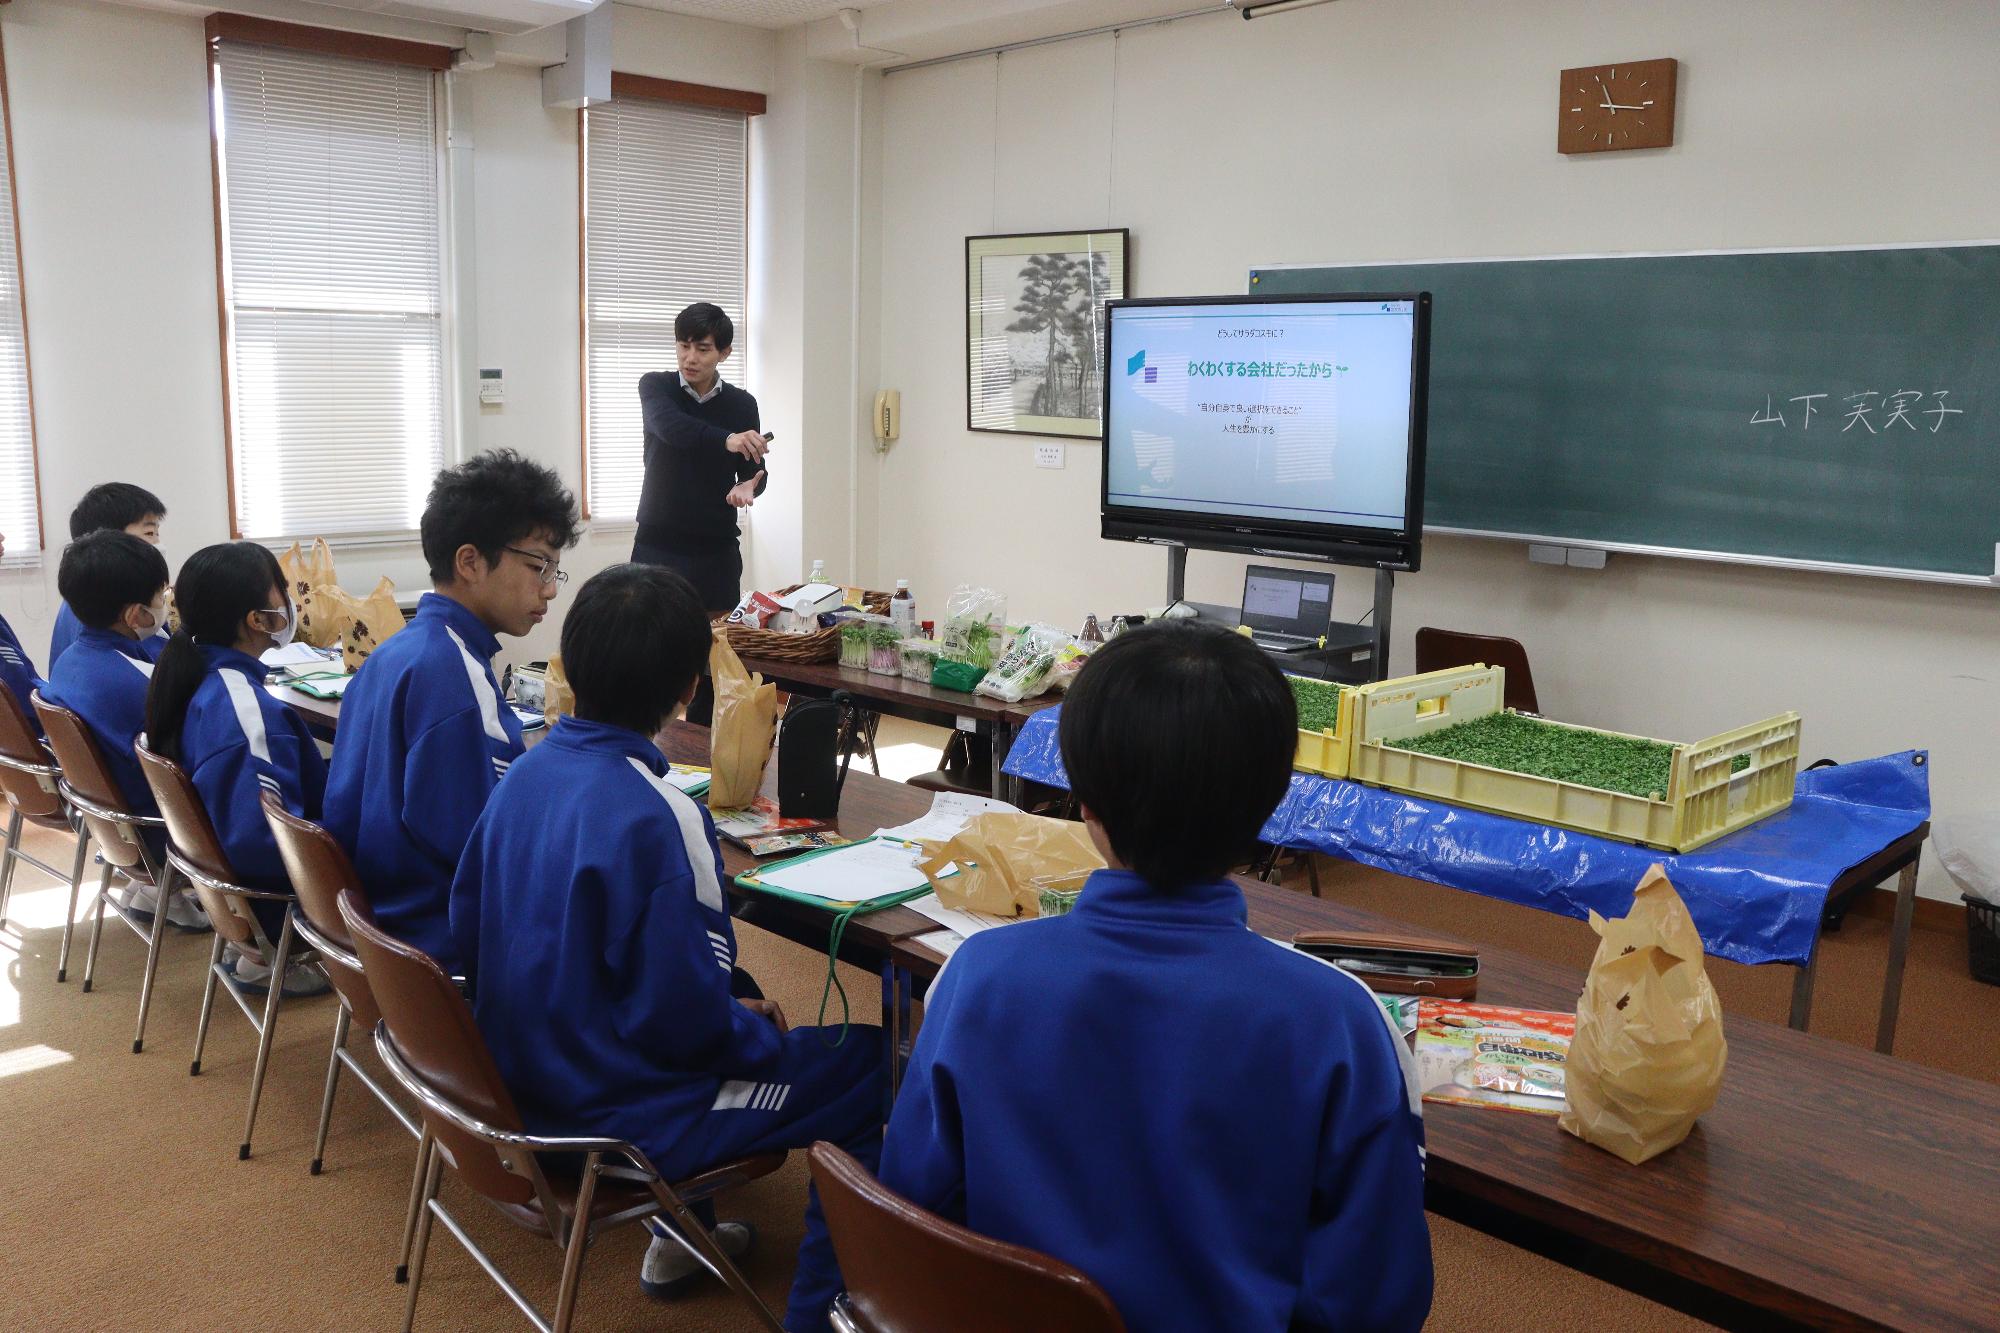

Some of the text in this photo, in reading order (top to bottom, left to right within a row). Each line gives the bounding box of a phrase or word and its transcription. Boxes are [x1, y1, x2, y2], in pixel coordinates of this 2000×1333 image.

[1187, 360, 1332, 378] わくわくする会社だったから
